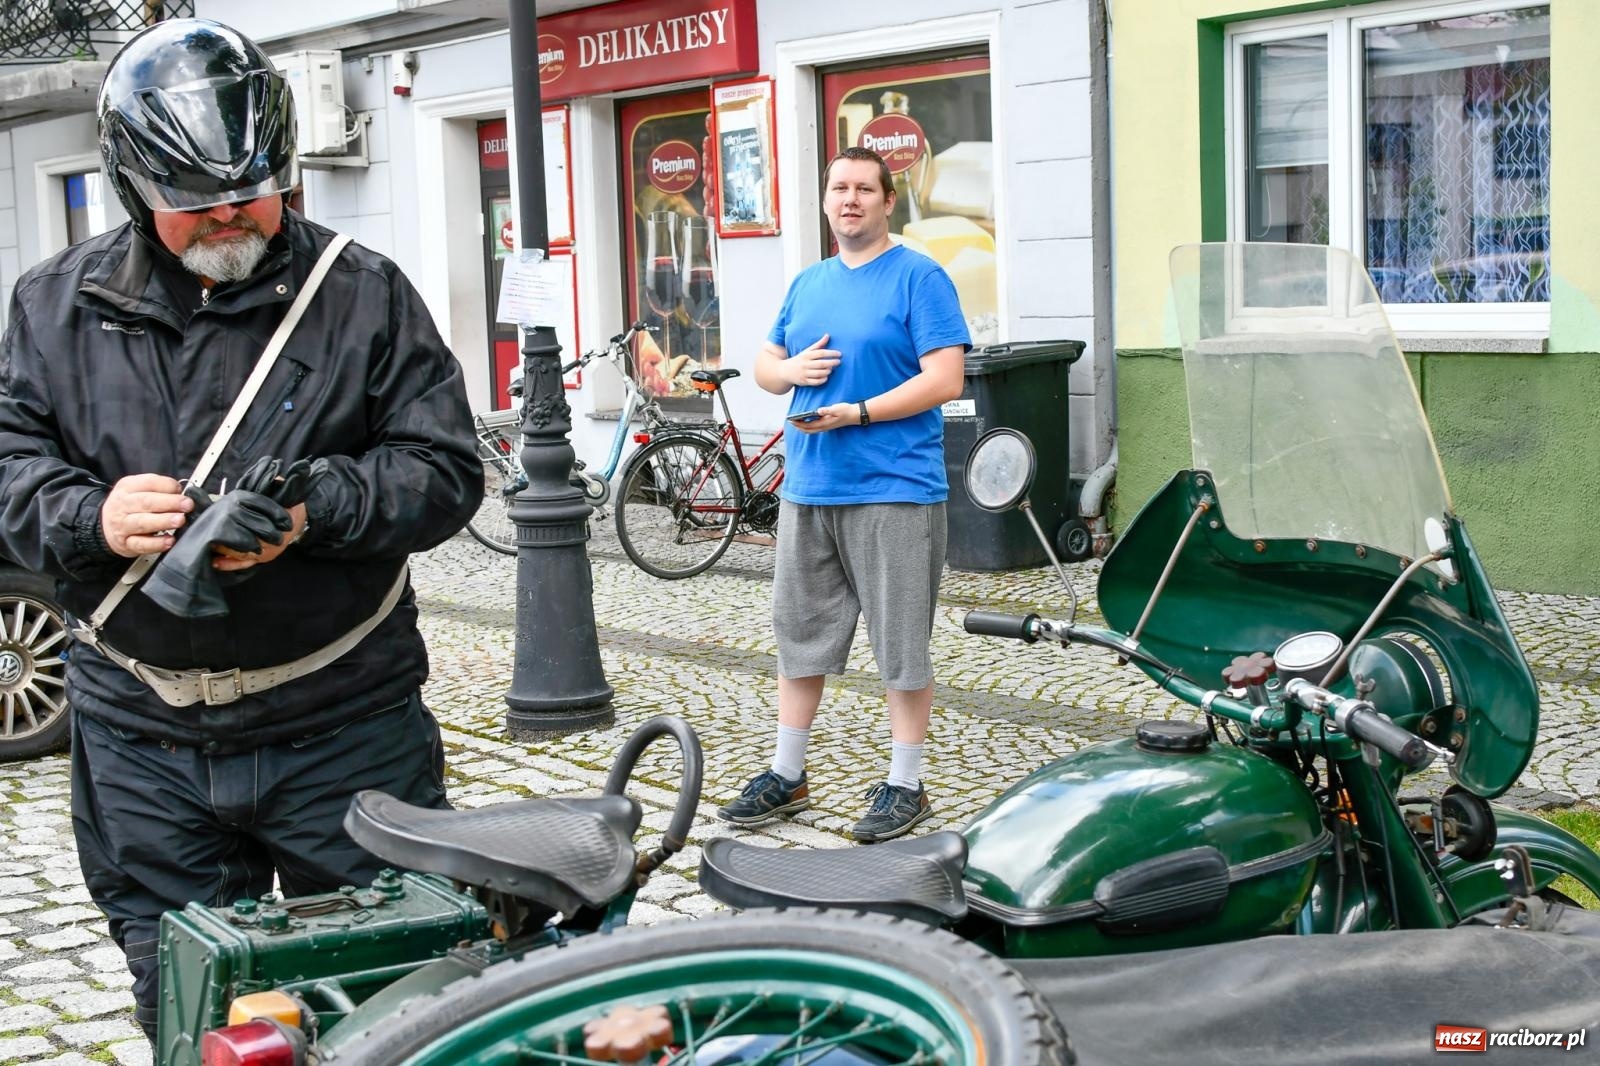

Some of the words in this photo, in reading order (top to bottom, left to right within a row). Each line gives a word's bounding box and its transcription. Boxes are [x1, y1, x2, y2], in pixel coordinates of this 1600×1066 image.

[577, 8, 729, 68] DELIKATESY
[538, 48, 565, 65] emium
[863, 131, 918, 152] Premium
[652, 155, 696, 174] Premium
